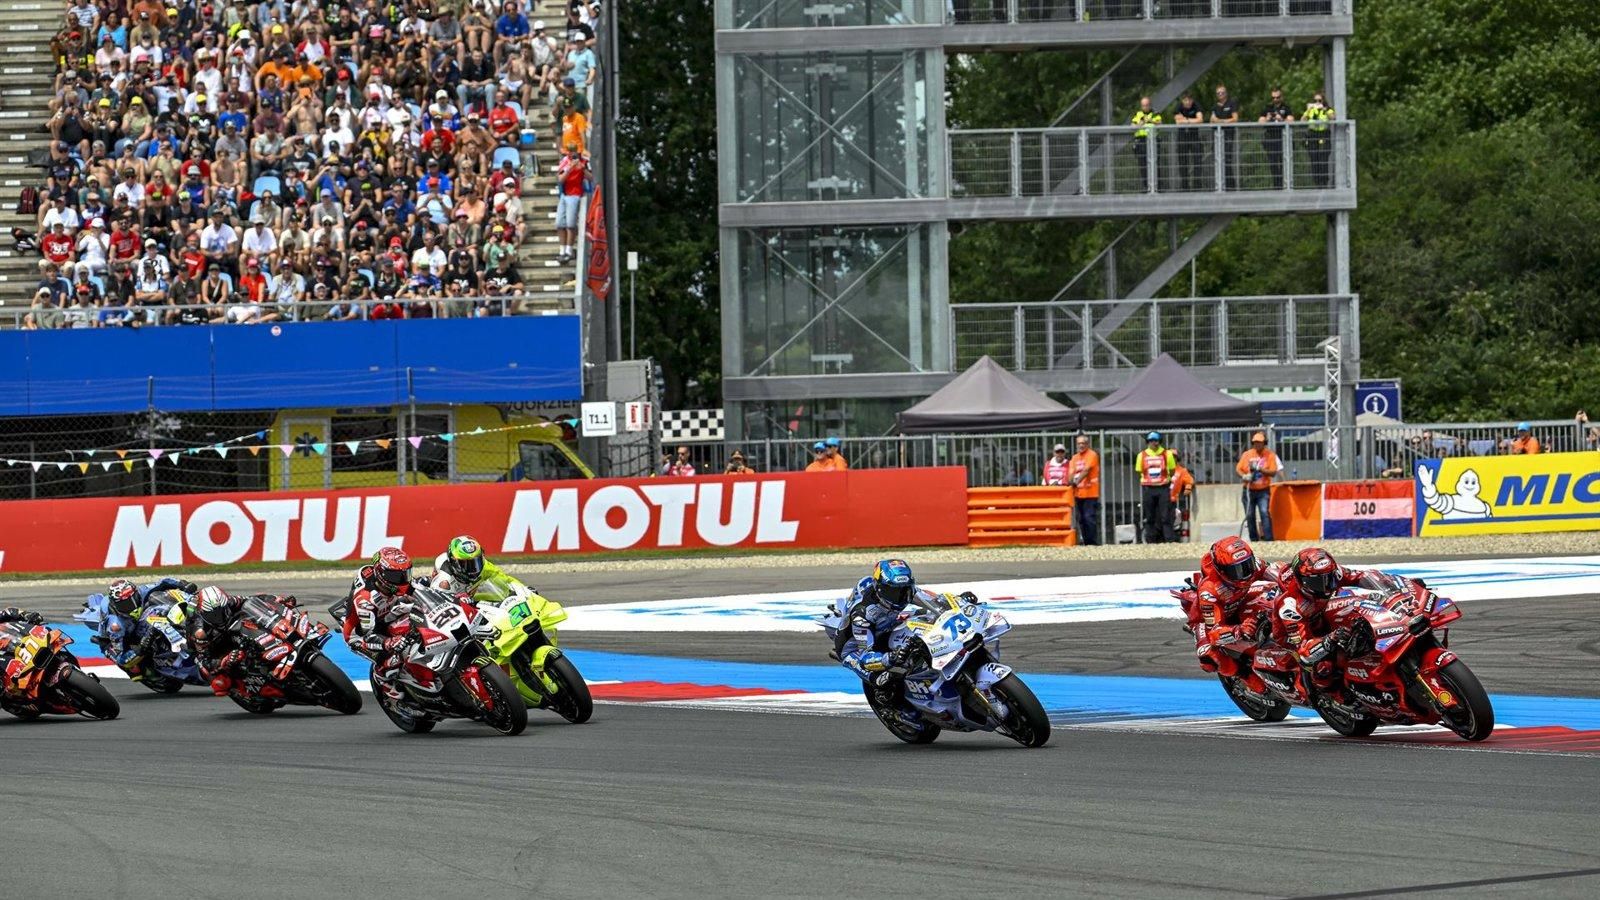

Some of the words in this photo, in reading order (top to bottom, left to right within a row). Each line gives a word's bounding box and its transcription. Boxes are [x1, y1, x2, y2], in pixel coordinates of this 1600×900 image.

[589, 414, 609, 425] T1.1
[1495, 472, 1600, 507] MIC
[501, 480, 799, 552] MOTUL
[1353, 502, 1376, 515] 100
[103, 495, 405, 569] MOTUL
[1424, 593, 1436, 612] Lenovo
[432, 606, 461, 629] 20
[942, 612, 972, 641] 73
[1377, 627, 1403, 635] Lenovo
[18, 637, 40, 664] 37
